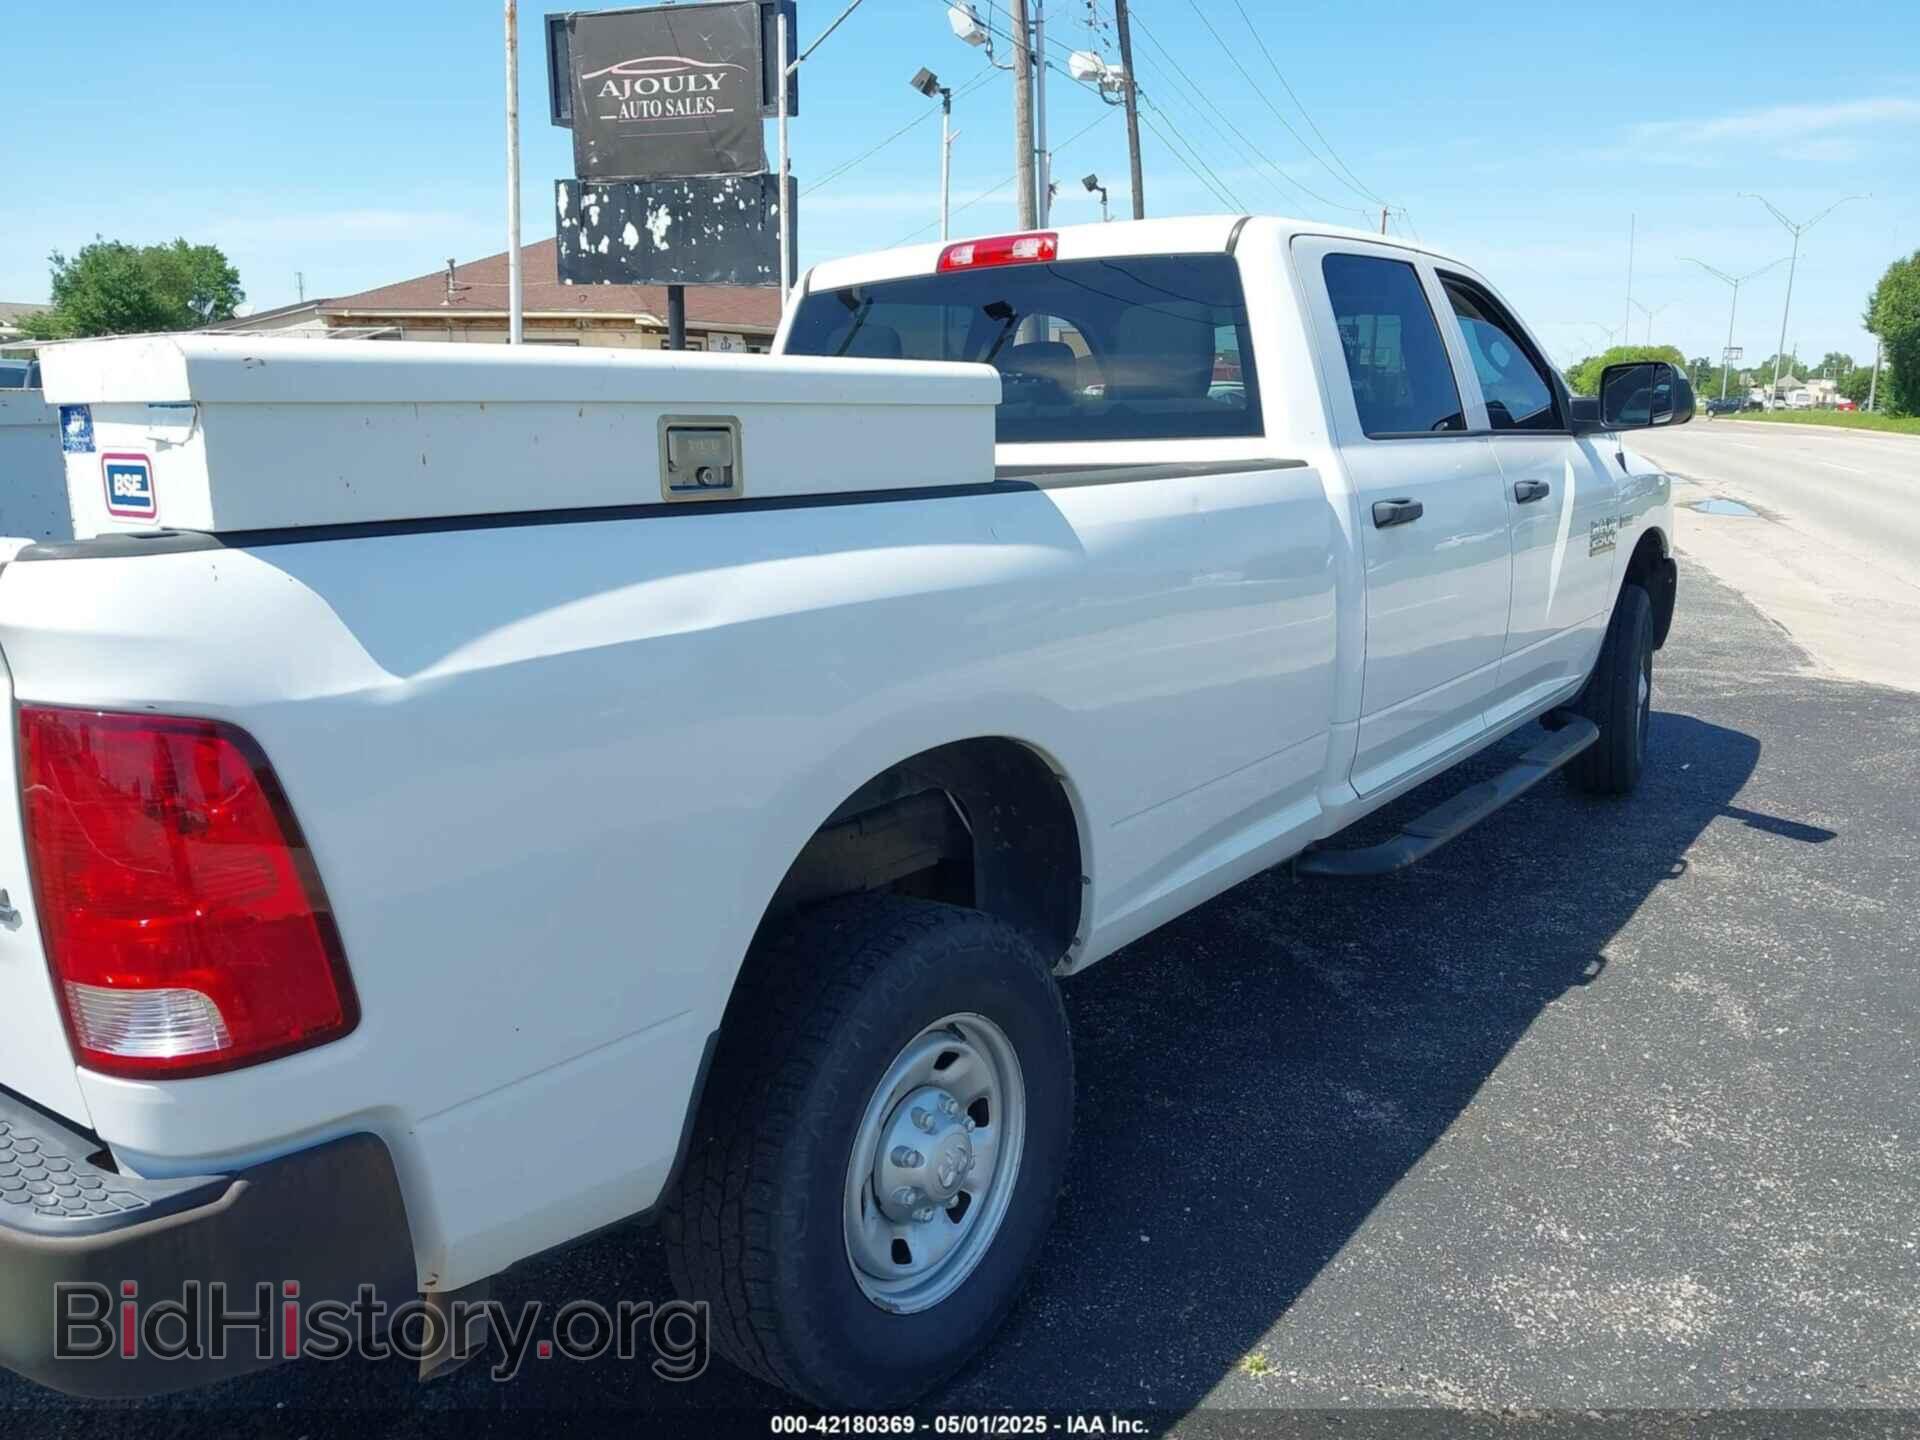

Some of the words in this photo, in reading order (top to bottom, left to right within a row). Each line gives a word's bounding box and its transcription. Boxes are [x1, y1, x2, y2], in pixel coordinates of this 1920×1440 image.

[597, 72, 727, 100] AJOULY
[619, 99, 662, 119] AUTO
[665, 96, 715, 117] SALES
[114, 473, 145, 497] BSE
